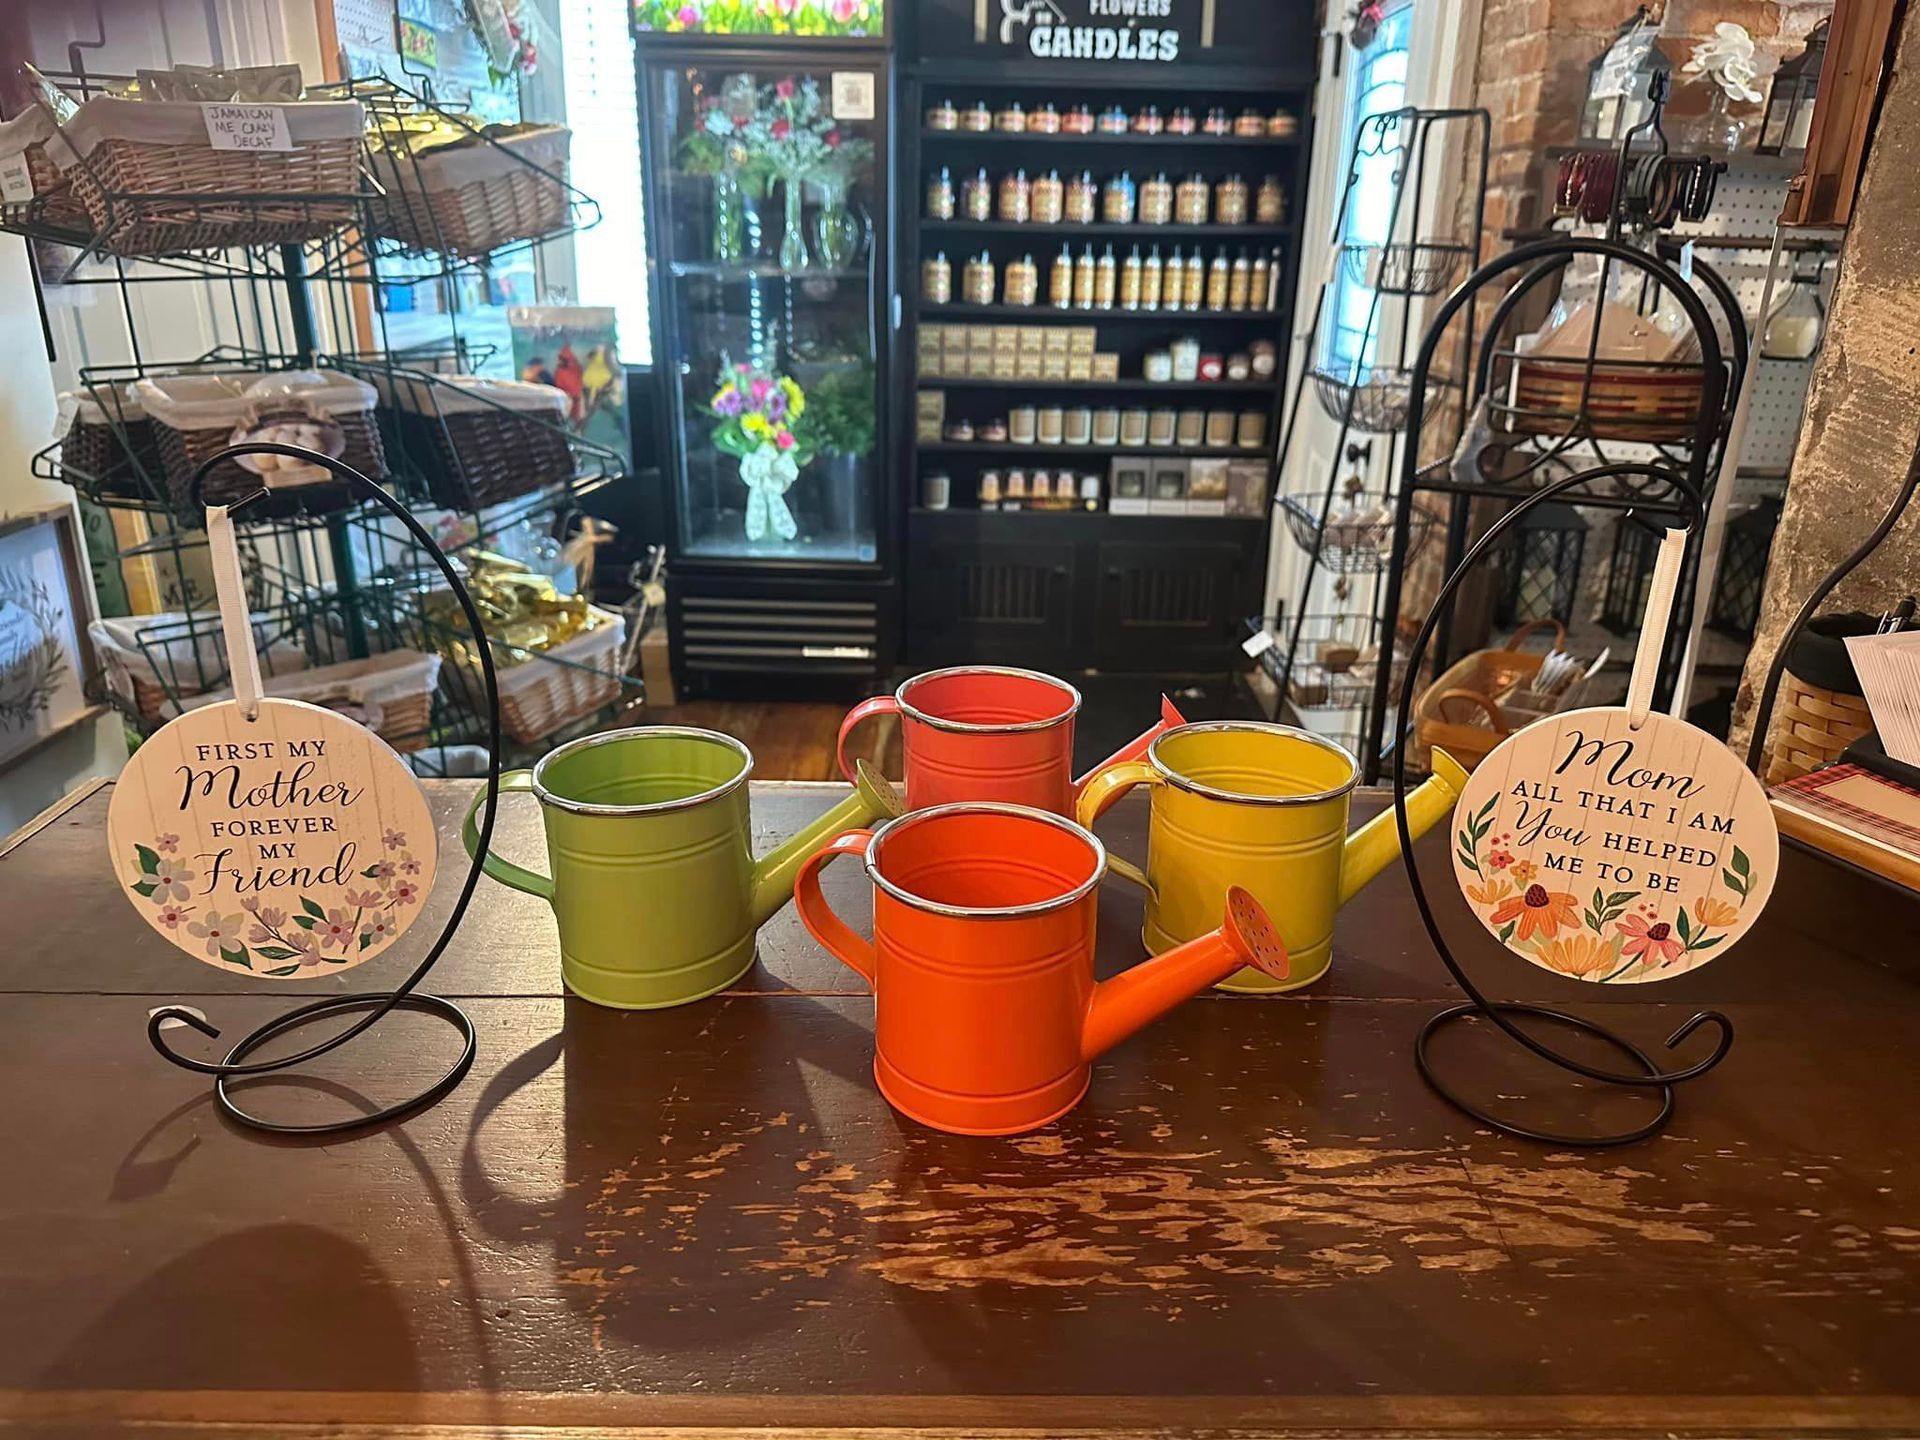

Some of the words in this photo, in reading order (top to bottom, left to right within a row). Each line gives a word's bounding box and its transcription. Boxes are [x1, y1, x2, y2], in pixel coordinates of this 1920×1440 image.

[1090, 0, 1172, 16] FLOWERS
[1029, 26, 1180, 61] CANDLES
[208, 106, 273, 119] JAMAICAN
[215, 121, 235, 133] ME
[233, 134, 272, 147] DECAF
[196, 742, 275, 761] FIRST
[286, 740, 326, 757] MY
[1555, 730, 1706, 799] Mom
[175, 761, 365, 810] Mother
[1511, 780, 1564, 803] ALL
[1578, 790, 1655, 819] THAT
[1666, 807, 1678, 824] I
[1688, 812, 1736, 834] AM
[210, 816, 337, 837] FOREVER
[1515, 800, 1592, 847] You
[1603, 832, 1717, 867] HELPED
[258, 843, 297, 859] MY
[193, 841, 357, 895] Friend
[1544, 852, 1584, 874] ME
[1597, 863, 1634, 883] TO
[1647, 872, 1681, 893] BE
